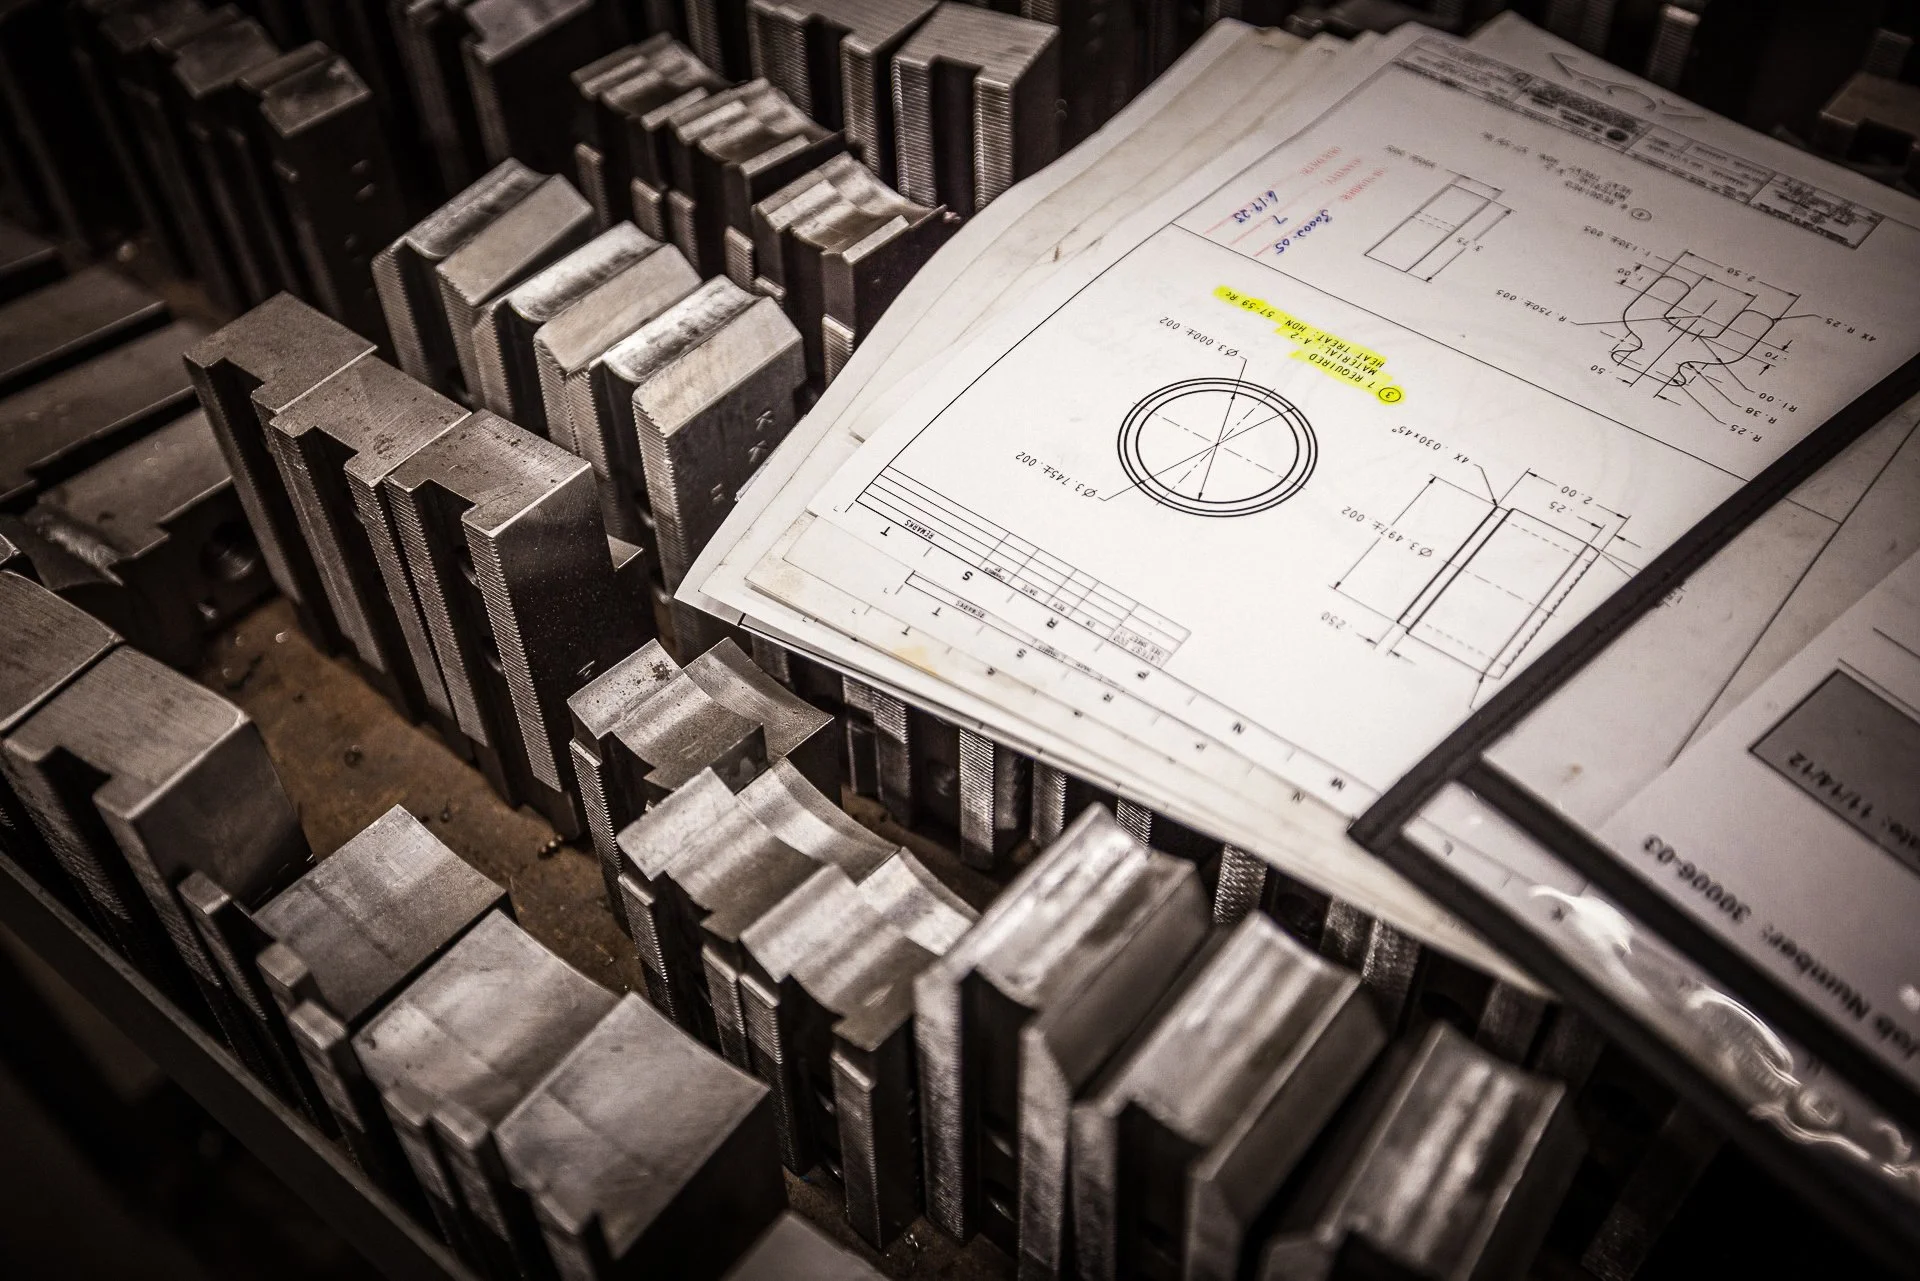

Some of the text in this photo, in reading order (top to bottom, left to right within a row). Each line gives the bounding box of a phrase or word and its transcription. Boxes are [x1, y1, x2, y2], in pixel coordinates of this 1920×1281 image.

[1617, 267, 1643, 281] 1.00
[1727, 267, 1757, 282] 2.50
[1242, 299, 1275, 318] 57-59
[1825, 318, 1878, 342] 4X R.25
[1314, 331, 1351, 354] TREAT:
[1290, 332, 1378, 376] MATERIAL: A-2
[1355, 351, 1385, 368] HEAT
[1765, 350, 1787, 361] .70
[1309, 353, 1364, 383] REQUIRED
[1590, 364, 1613, 375] .50
[1745, 407, 1778, 425] R.38
[1730, 424, 1762, 443] R.25
[1453, 452, 1470, 464] 4X
[1560, 486, 1593, 505] 2.00
[1549, 501, 1573, 514] .25
[880, 526, 891, 537] T
[903, 519, 934, 540] REMARKS
[961, 571, 974, 581] S
[932, 607, 942, 617] T
[1046, 617, 1059, 629] R
[1320, 611, 1353, 631] .250
[901, 625, 911, 636] T
[1016, 649, 1027, 658] S
[1232, 722, 1246, 735] N
[1331, 777, 1346, 791] M
[1788, 751, 1874, 820] 11/14/12
[1642, 834, 1752, 925] 30006-03
[1762, 924, 1871, 1021] Number:
